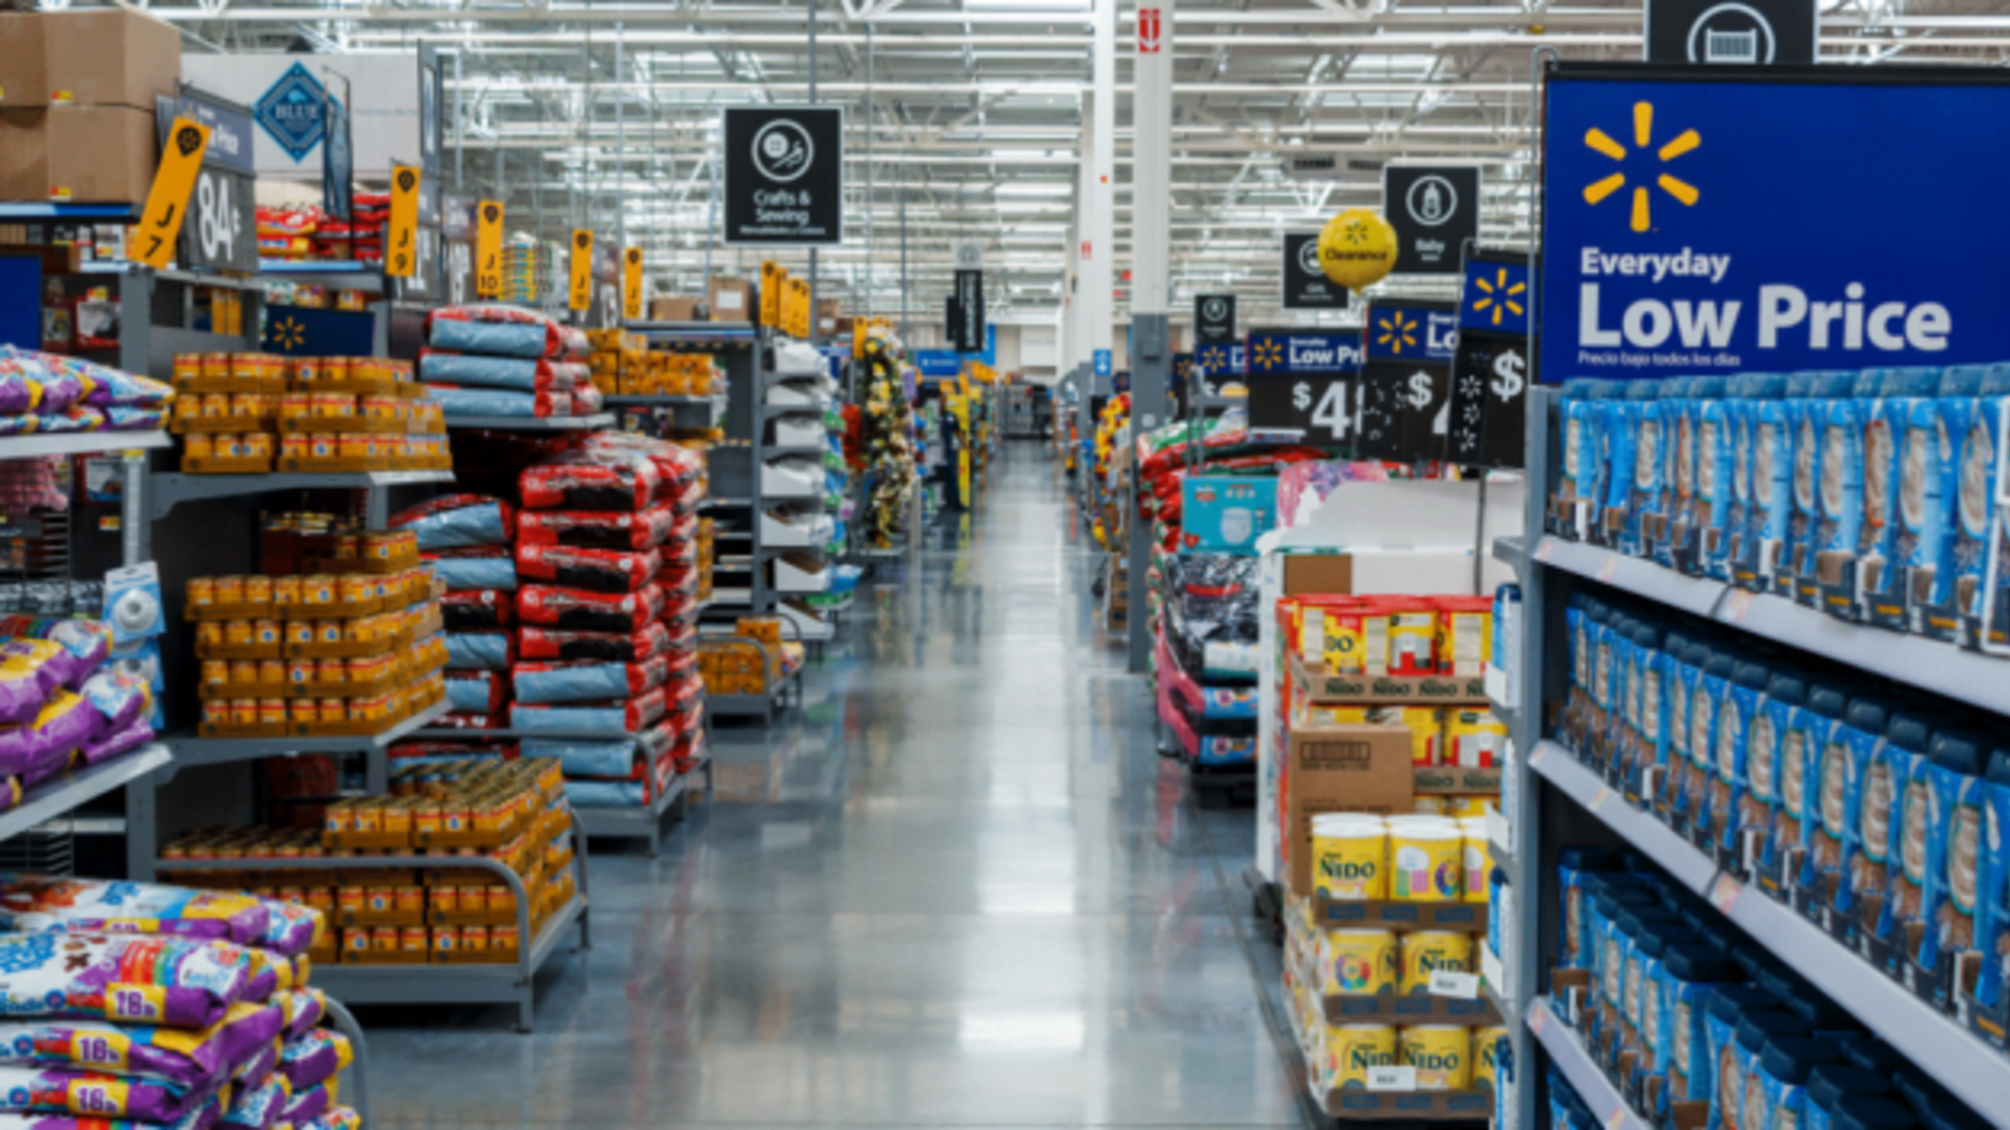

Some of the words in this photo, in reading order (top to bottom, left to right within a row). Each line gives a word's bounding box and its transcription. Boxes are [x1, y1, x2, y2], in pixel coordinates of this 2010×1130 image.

[754, 189, 797, 206] Crafts
[799, 190, 811, 206] &
[156, 203, 175, 228] J
[756, 207, 810, 226] Sewing
[144, 234, 164, 258] 7
[397, 226, 409, 248] J
[1325, 247, 1388, 261] Clearance
[1580, 246, 1730, 283] Everyday
[1578, 282, 1741, 348] Low
[1757, 282, 1952, 351] Price
[1427, 324, 1461, 349] Lo
[1289, 346, 1333, 364] Low
[1337, 346, 1367, 364] Pri
[1490, 349, 1525, 402] $
[1319, 857, 1377, 880] NIDO
[1420, 955, 1468, 976] NID
[114, 990, 143, 1017] 16
[79, 1036, 107, 1063] 16
[1404, 1049, 1458, 1070] NIDO
[78, 1086, 106, 1113] 16
